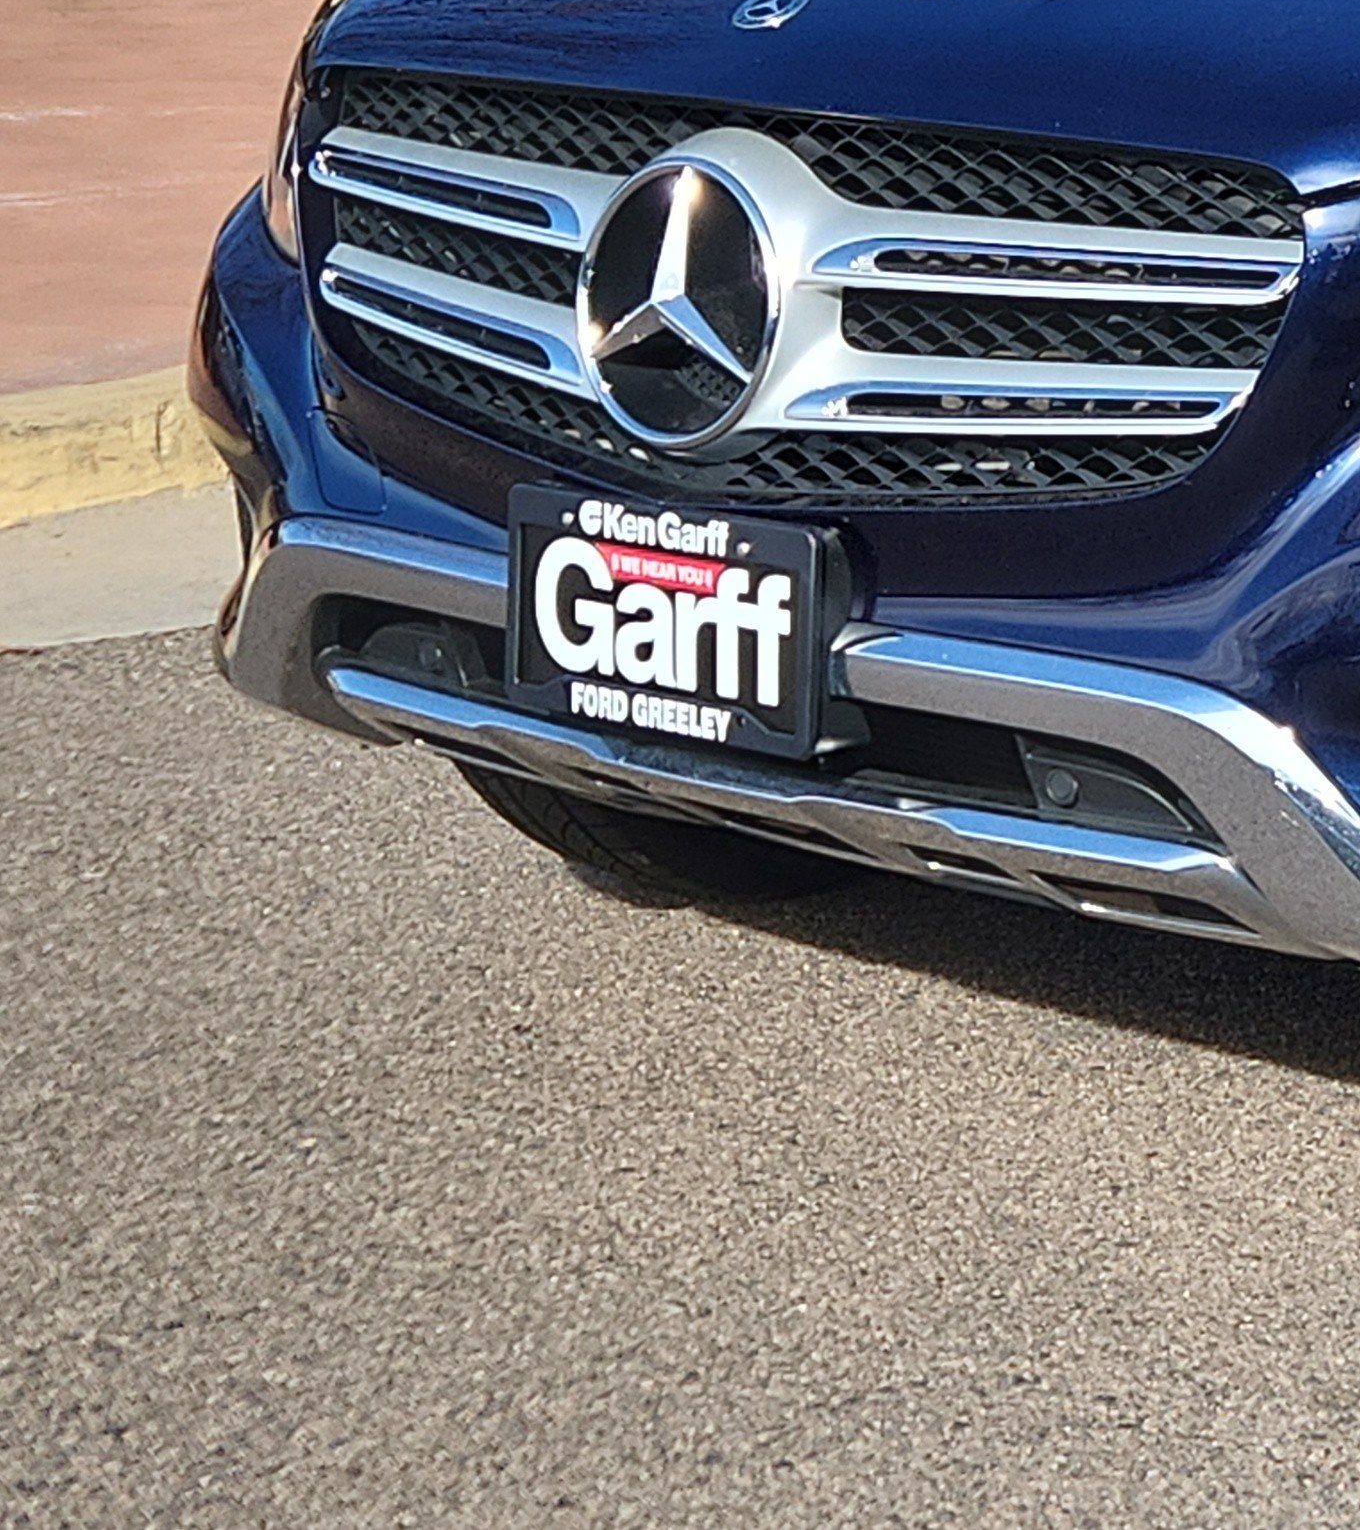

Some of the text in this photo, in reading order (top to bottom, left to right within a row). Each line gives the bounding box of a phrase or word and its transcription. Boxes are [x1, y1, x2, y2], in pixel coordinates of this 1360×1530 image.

[602, 501, 731, 558] Ken Garff
[620, 554, 641, 576] WE
[677, 564, 705, 586] YOU
[534, 536, 792, 708] Garff
[570, 682, 732, 743] FORD GREELEY
